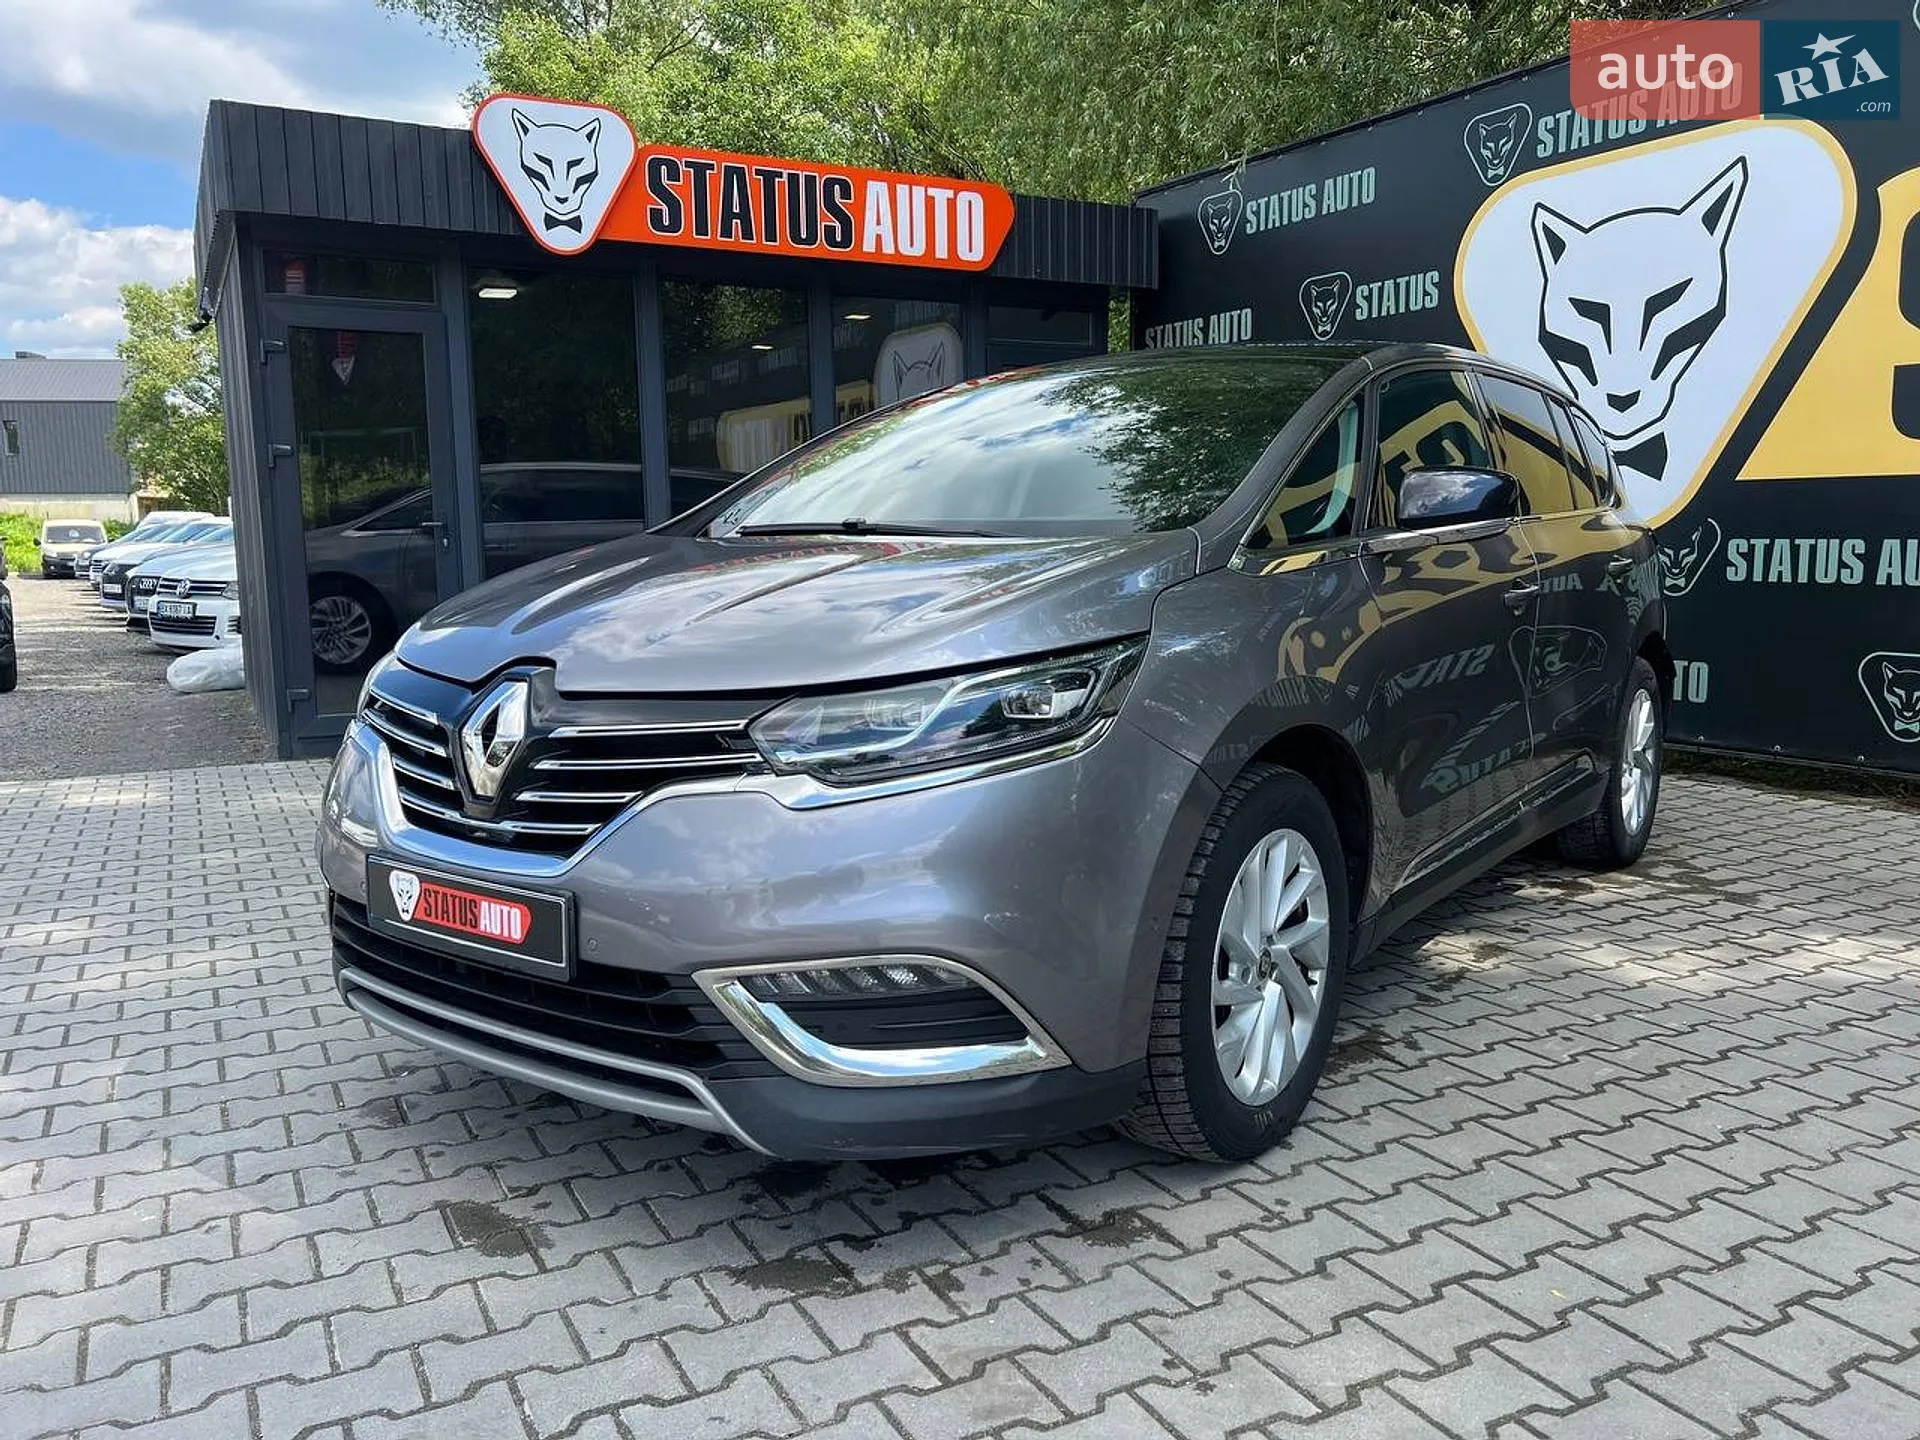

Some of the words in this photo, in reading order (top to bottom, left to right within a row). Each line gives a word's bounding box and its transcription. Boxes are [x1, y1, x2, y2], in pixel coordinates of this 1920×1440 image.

[1536, 89, 1648, 159] STATUS
[645, 154, 855, 252] STATUS
[862, 179, 985, 262] AUTO
[1245, 183, 1316, 235] STATUS
[1322, 166, 1376, 216] AUTO
[1355, 271, 1440, 321] STATUS
[1208, 308, 1252, 344] AUTO
[1726, 538, 1866, 585] STATUS
[423, 888, 478, 929] STATUS
[479, 901, 522, 940] AUTO
